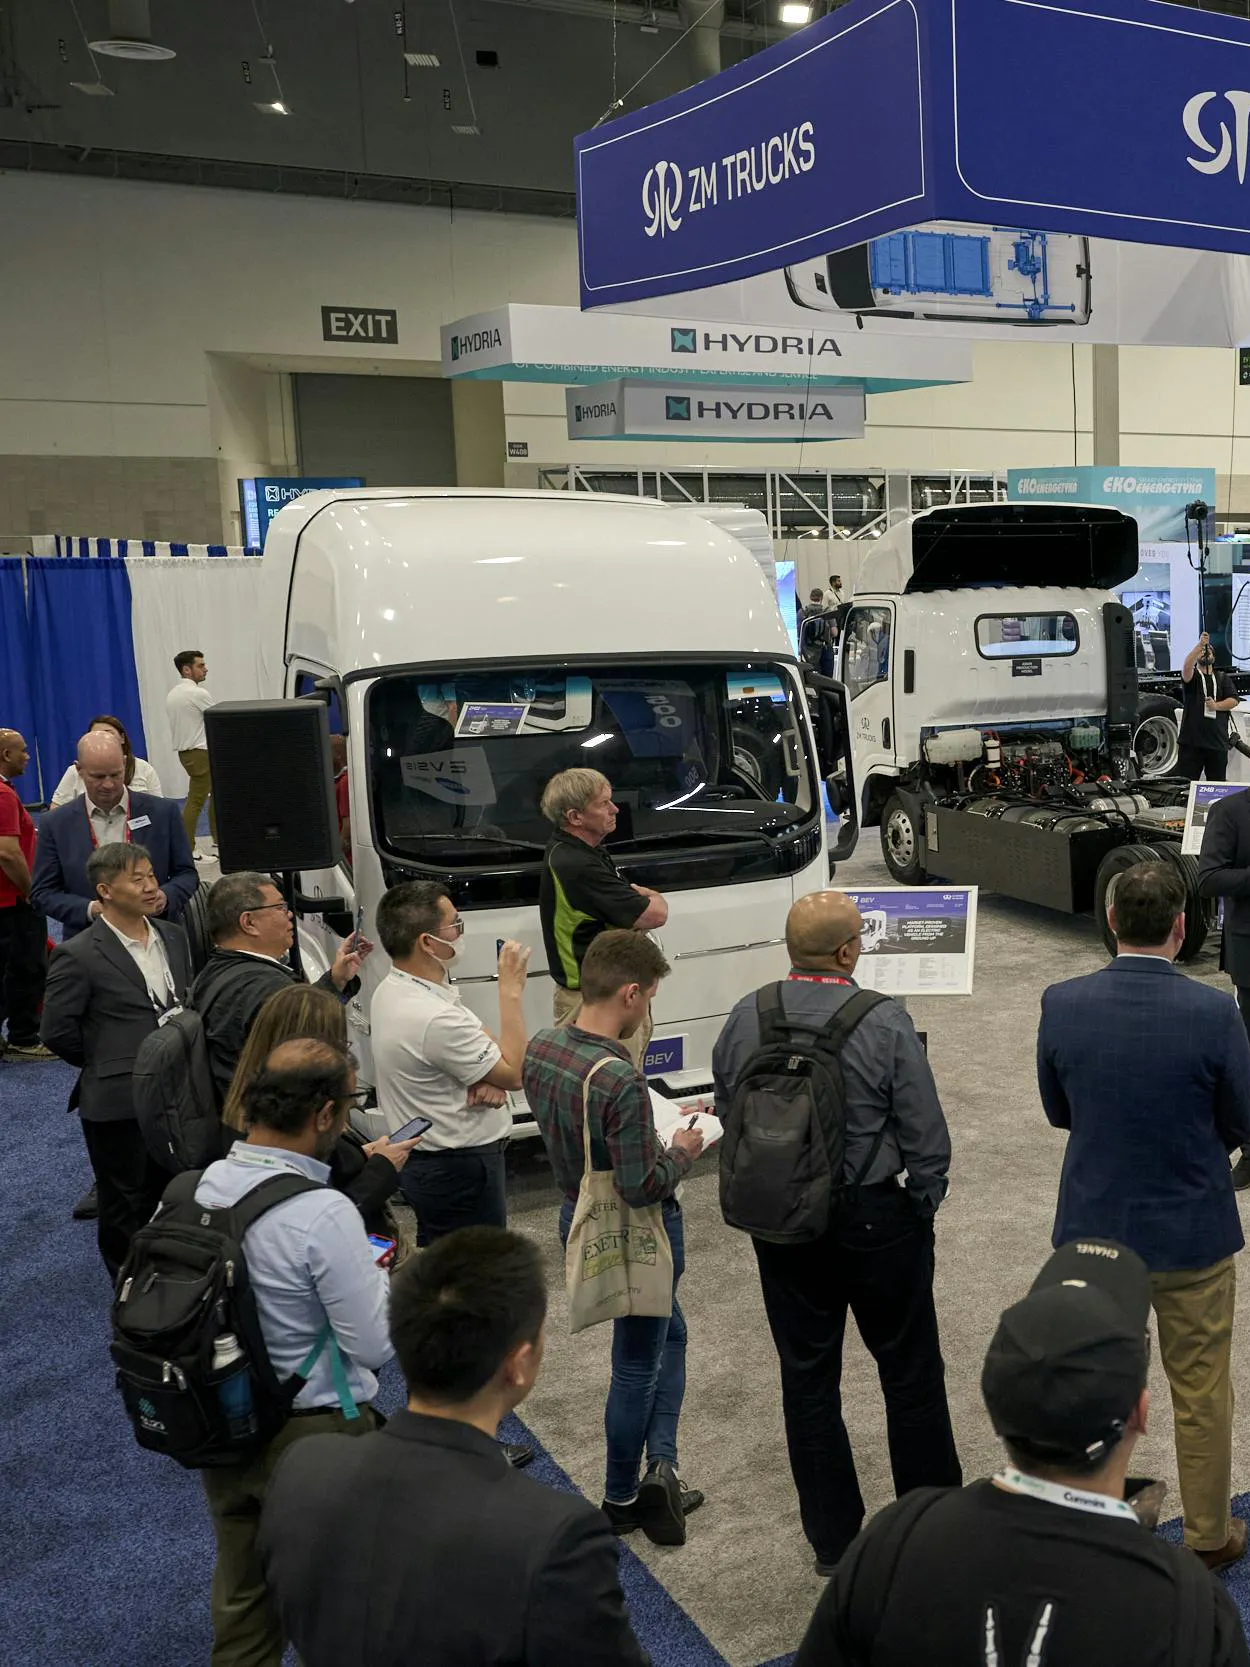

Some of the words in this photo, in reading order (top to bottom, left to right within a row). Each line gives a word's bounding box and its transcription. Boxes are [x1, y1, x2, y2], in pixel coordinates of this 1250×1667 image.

[688, 165, 717, 212] ZM
[723, 121, 816, 198] TRUCKS
[329, 311, 391, 337] EXIT
[459, 329, 502, 355] HYDRIA
[704, 333, 842, 357] HYDRIA
[582, 402, 616, 420] HYDRIA
[698, 401, 834, 420] HYDRIA
[645, 1051, 673, 1066] BEV
[1076, 1243, 1119, 1259] CHANEL
